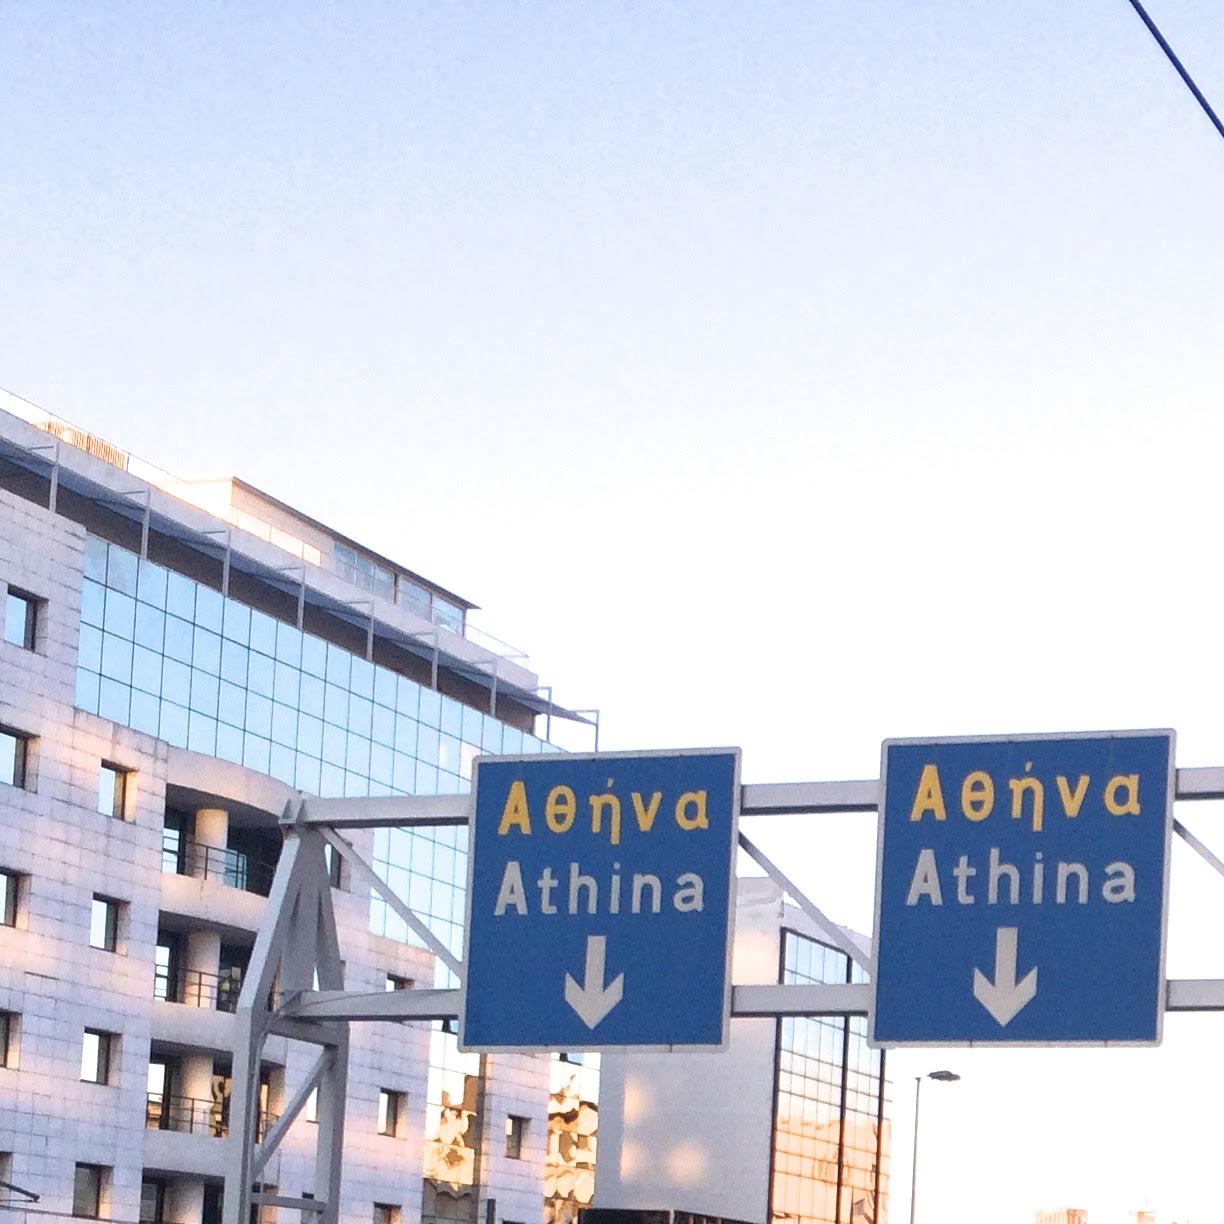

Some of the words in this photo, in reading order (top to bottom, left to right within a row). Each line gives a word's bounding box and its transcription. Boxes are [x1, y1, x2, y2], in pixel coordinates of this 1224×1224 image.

[497, 778, 709, 845] Αθήνα
[910, 762, 1141, 832] Αθήνα
[494, 861, 704, 916] Athina
[906, 848, 1136, 906] Athina
